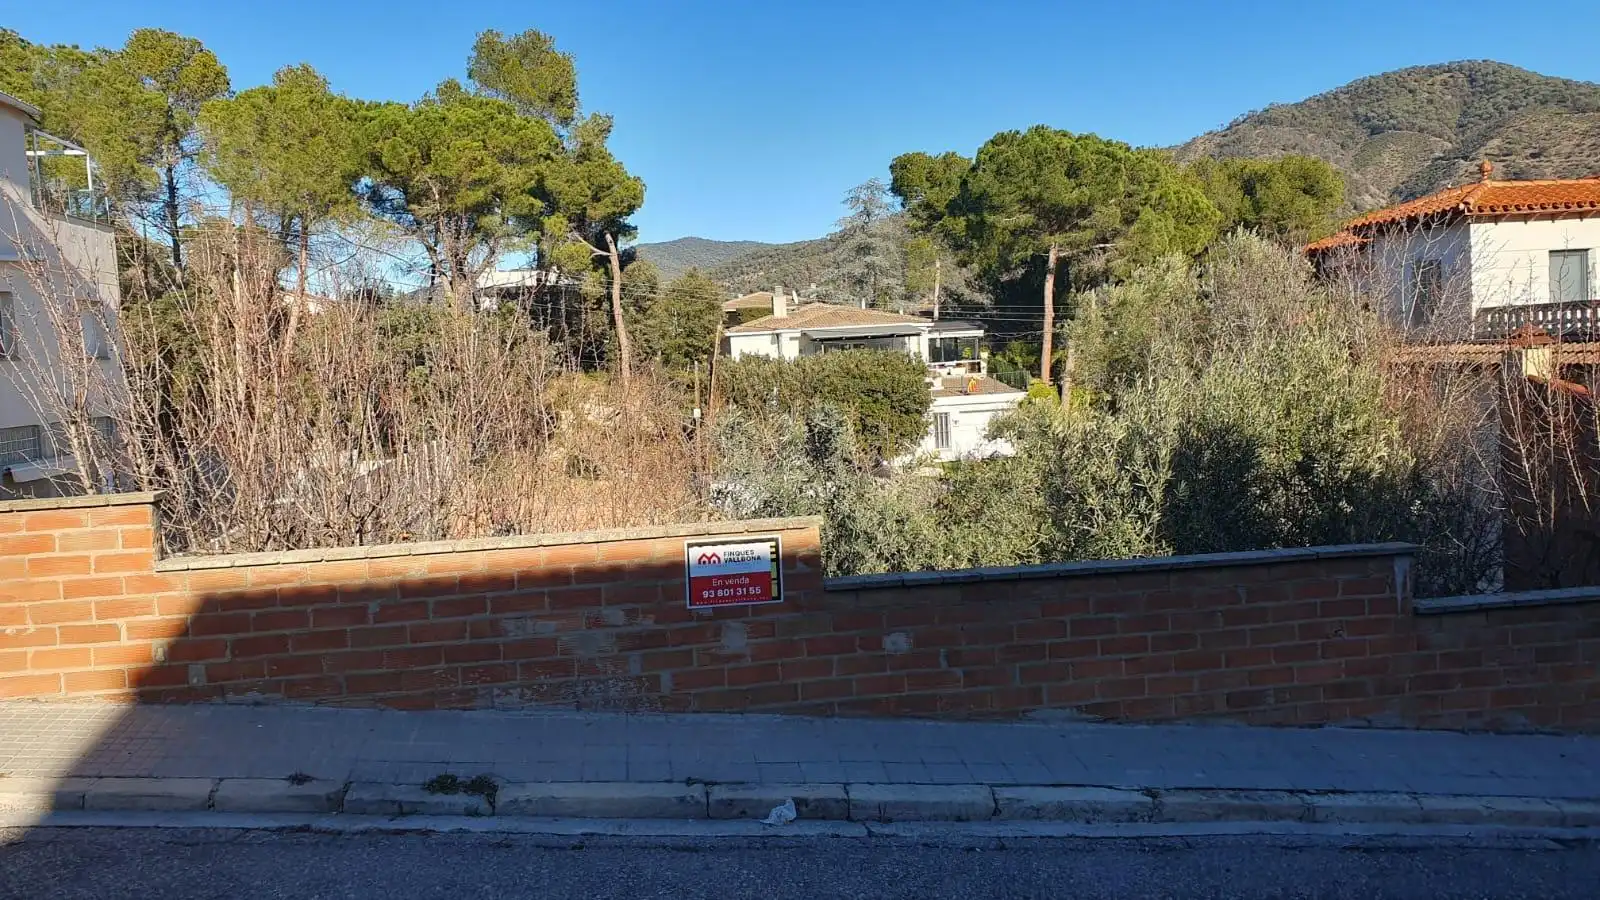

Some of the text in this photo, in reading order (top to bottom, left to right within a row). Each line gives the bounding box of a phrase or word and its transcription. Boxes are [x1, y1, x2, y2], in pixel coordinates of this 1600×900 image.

[724, 556, 762, 564] VALLBONA
[712, 576, 750, 586] En venda
[736, 588, 746, 596] 31
[749, 586, 761, 594] 55
